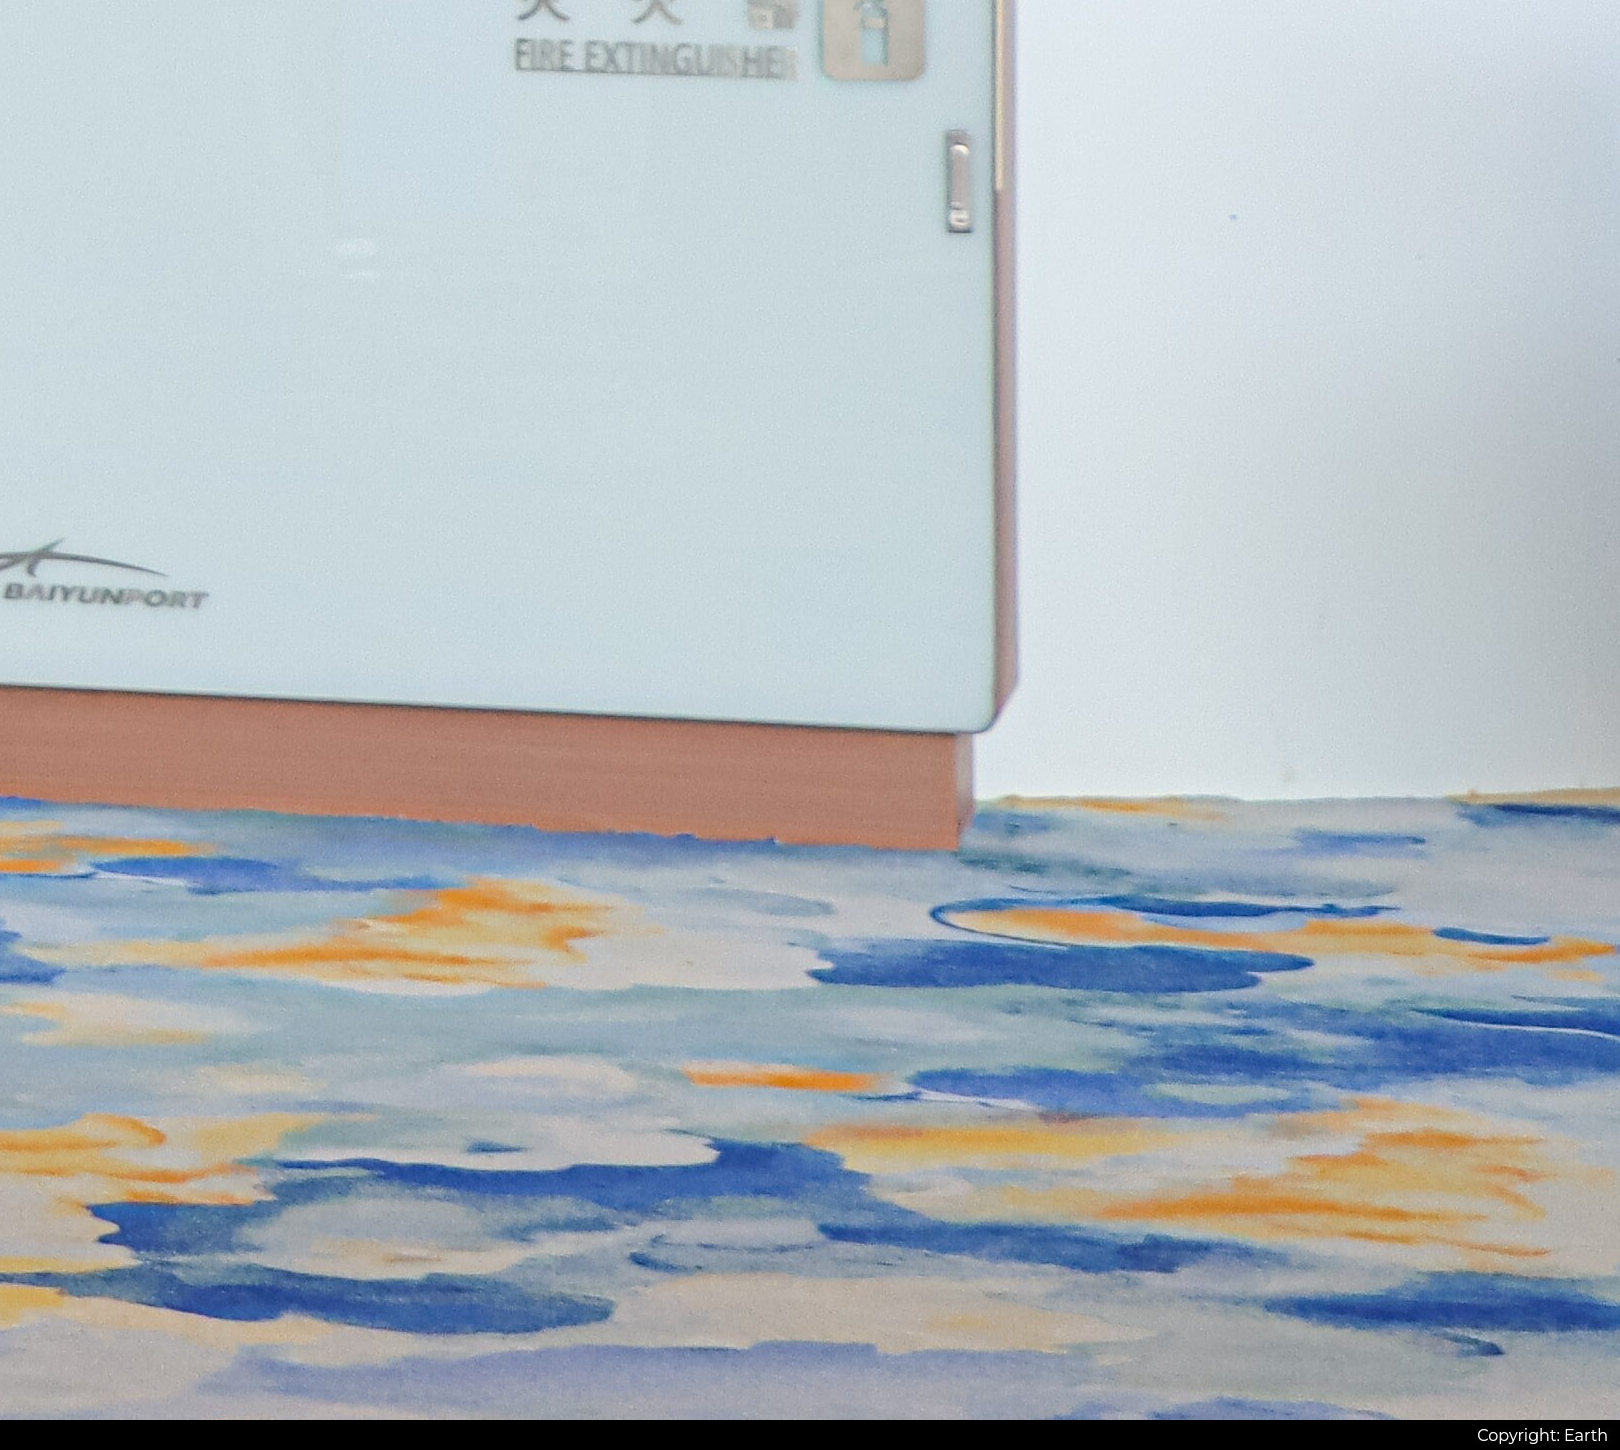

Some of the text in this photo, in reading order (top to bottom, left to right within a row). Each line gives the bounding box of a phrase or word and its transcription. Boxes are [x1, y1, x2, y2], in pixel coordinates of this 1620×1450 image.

[514, 38, 798, 81] FIRE EXTINGUISHER
[3, 582, 210, 610] BAIYUNPORT
